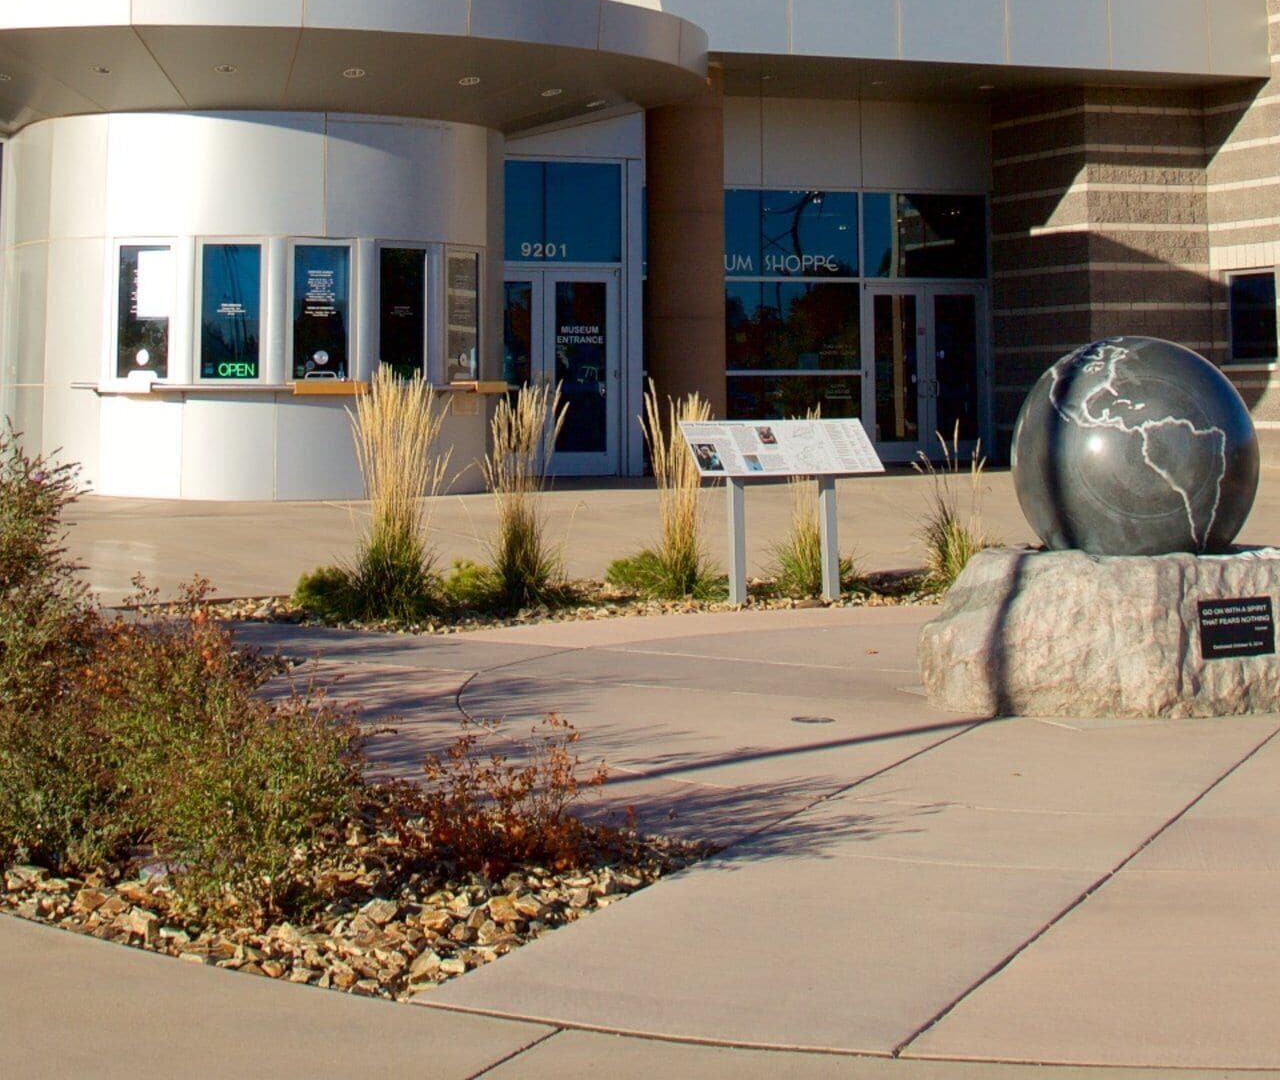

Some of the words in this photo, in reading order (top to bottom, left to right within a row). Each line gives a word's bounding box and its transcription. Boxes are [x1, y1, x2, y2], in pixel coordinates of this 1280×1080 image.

[521, 242, 567, 258] 9201
[764, 254, 839, 272] SHOPPE
[560, 325, 600, 334] MUSEUM
[556, 335, 604, 344] ENTRANCE
[218, 363, 255, 377] OPEN
[1202, 608, 1213, 616] GO
[1224, 606, 1240, 614] WITH
[1247, 604, 1267, 612] SPIRIT
[1202, 618, 1218, 626] THAT
[1241, 614, 1270, 623] NOTHING
